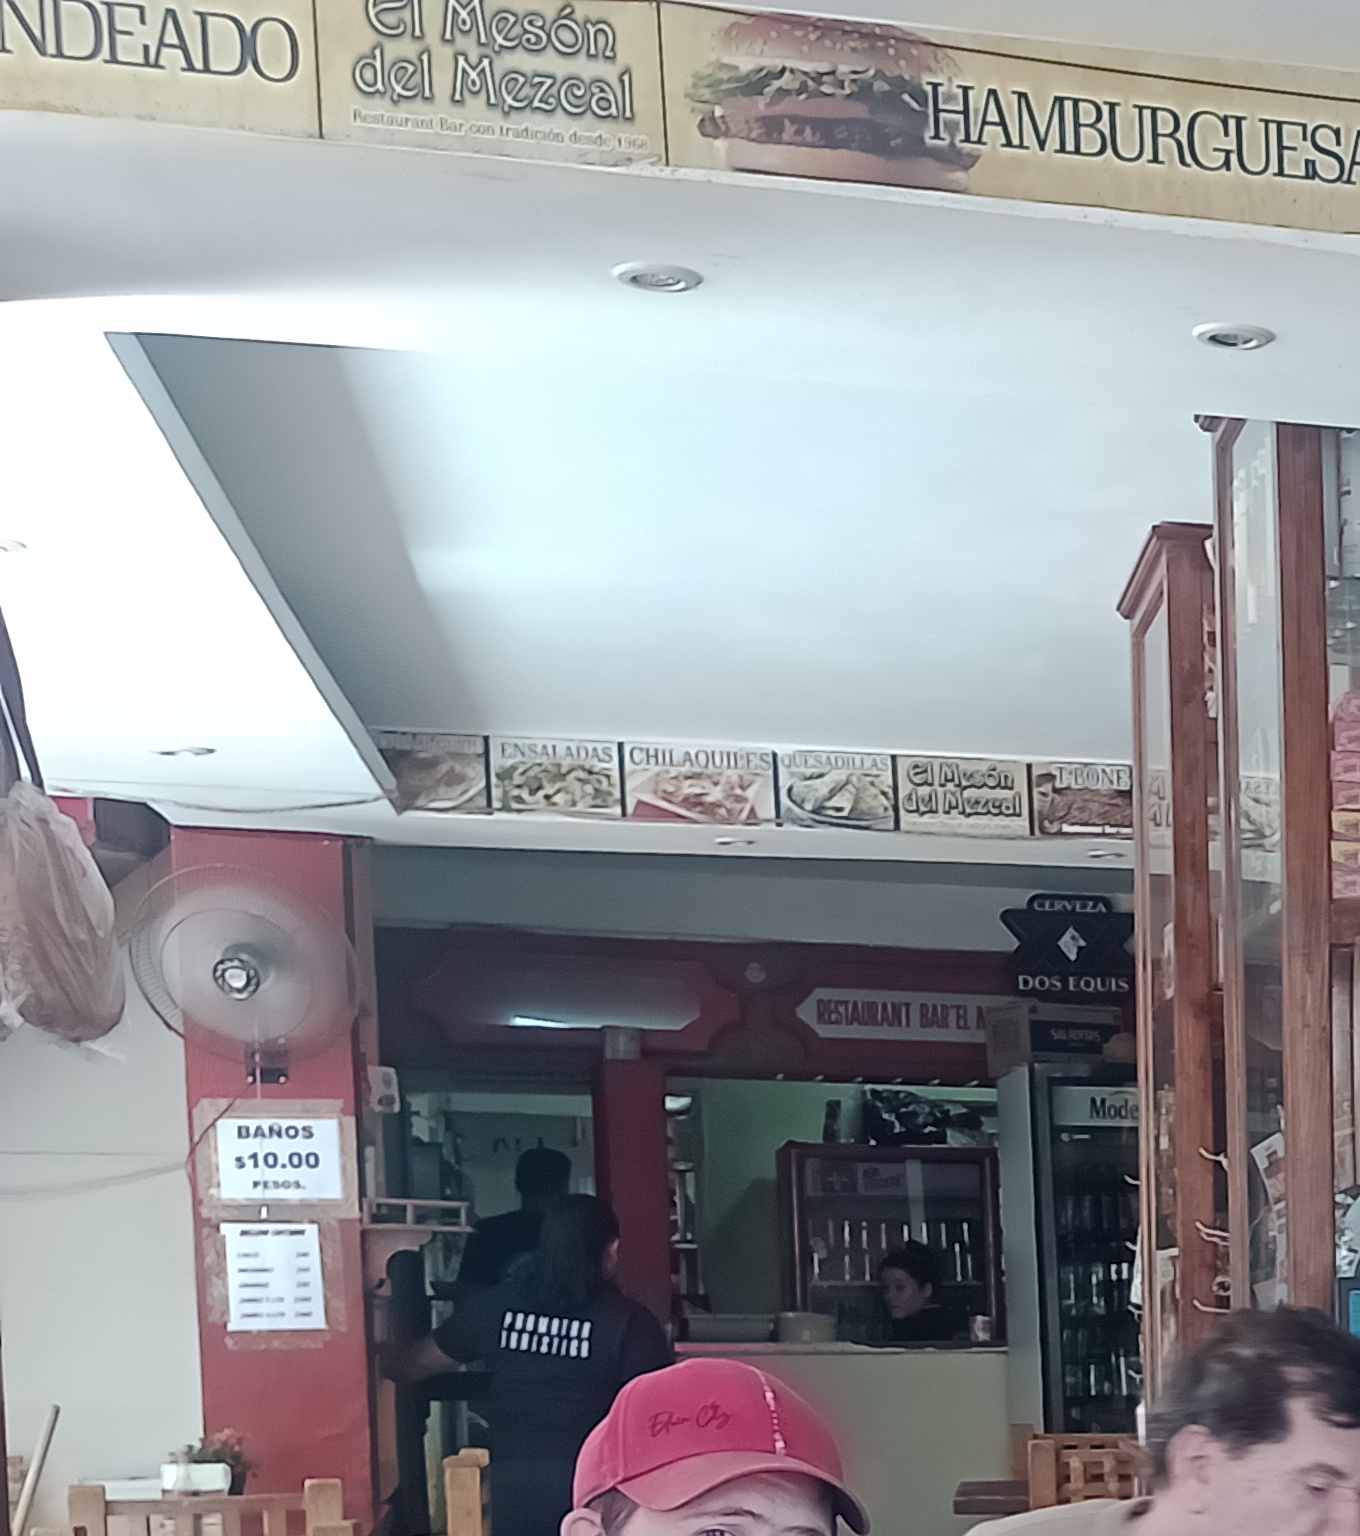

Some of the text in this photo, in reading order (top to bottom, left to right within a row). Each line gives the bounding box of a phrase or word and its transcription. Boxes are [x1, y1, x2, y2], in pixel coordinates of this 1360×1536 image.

[0, 0, 300, 83] NDEADO
[364, 0, 617, 60] El Mesón
[351, 43, 635, 121] del Mezcal
[469, 123, 495, 137] con
[500, 742, 613, 764] ENSALADAS
[628, 746, 772, 772] CHILAQUILES
[780, 750, 890, 772] QUESADILLAS
[907, 760, 1015, 790] El Mesón
[902, 788, 1022, 818] del Mezcal
[1033, 898, 1108, 913] CERVEZA
[1017, 973, 1130, 994] DOS EQUIS
[815, 998, 912, 1029] RESTAURANT
[236, 1121, 315, 1140] BAÑOS
[234, 1151, 320, 1170] $10.00
